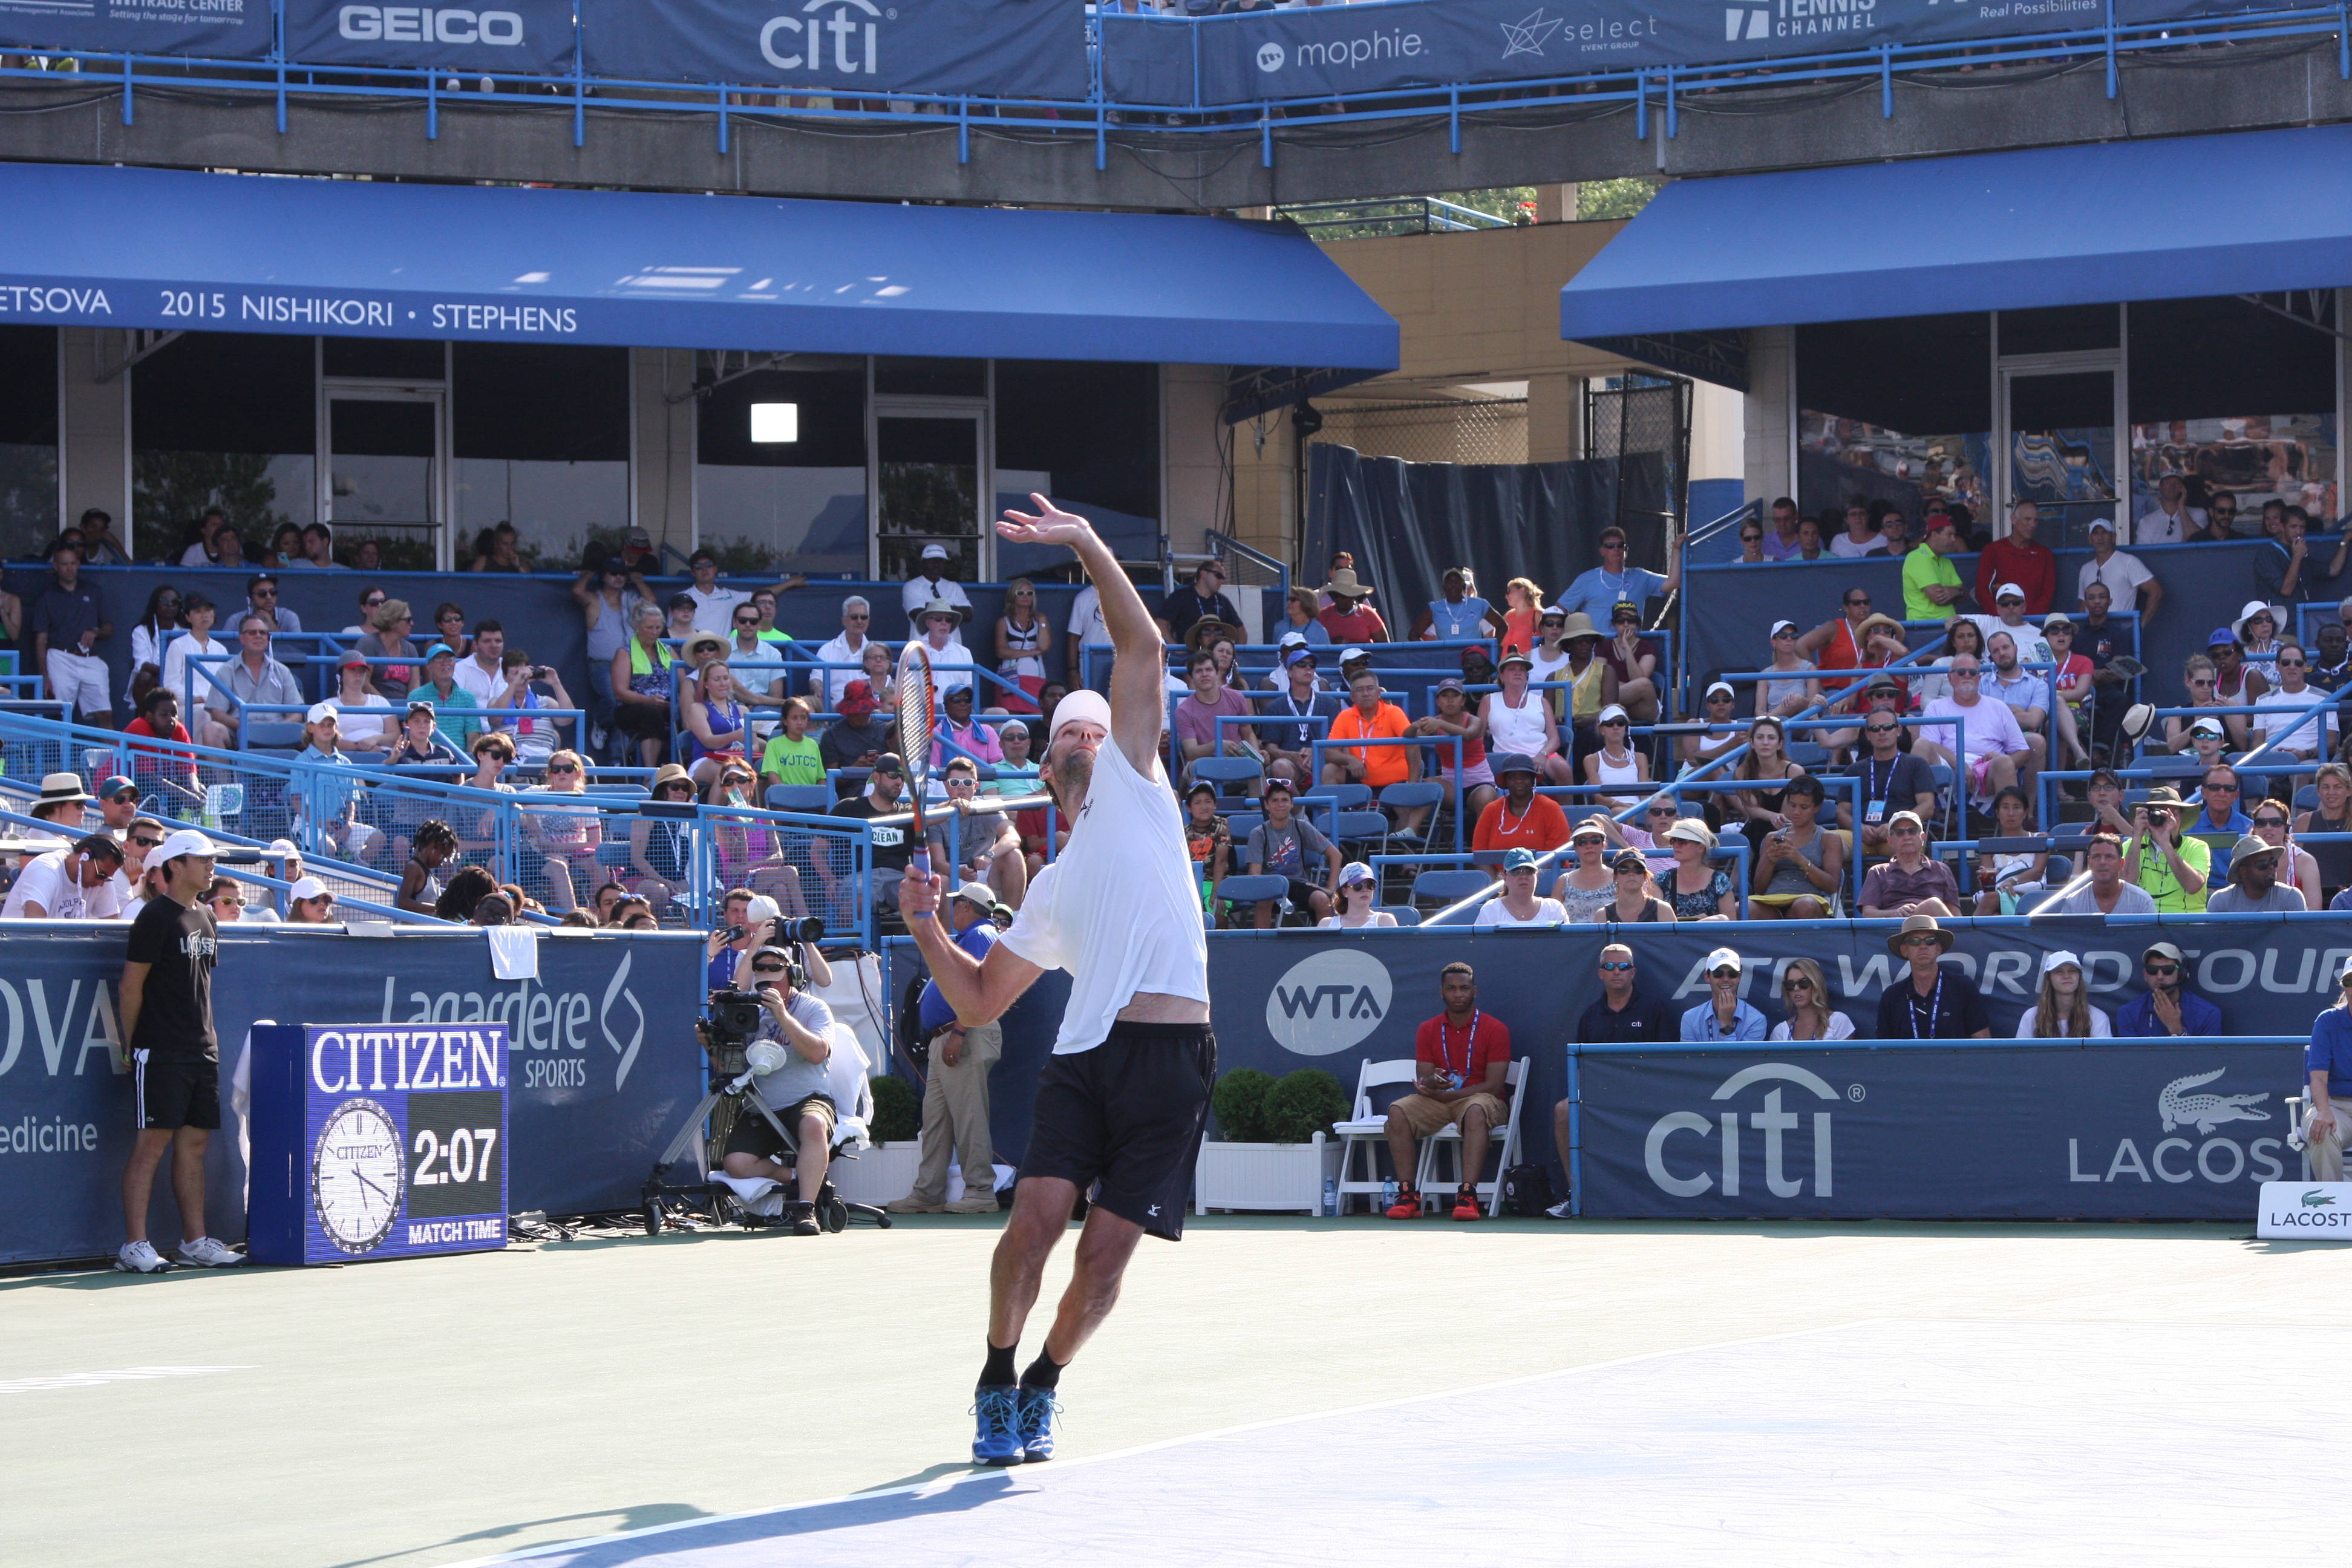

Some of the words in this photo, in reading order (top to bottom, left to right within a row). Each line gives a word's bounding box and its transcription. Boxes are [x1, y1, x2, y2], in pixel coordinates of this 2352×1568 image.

[109, 9, 140, 21] Setting
[143, 11, 156, 21] the
[159, 13, 183, 23] stage
[183, 13, 198, 24] for
[200, 15, 244, 25] tomorrow
[190, 0, 244, 12] CENTER
[1777, 0, 1875, 18] TENNIS
[1980, 3, 2009, 18] Real
[2014, 0, 2097, 15] Possibilities
[339, 5, 523, 46] GEICO
[1564, 15, 1657, 41] select
[1777, 13, 1873, 36] CHANNEL
[760, 5, 876, 74] citi
[1298, 28, 1422, 68] mophie
[1581, 43, 1608, 52] EVENT
[1610, 41, 1639, 51] GROUP
[161, 290, 226, 318] 2015
[243, 295, 392, 326] NISHIKORI
[433, 304, 577, 332] STEPHENS
[788, 755, 817, 768] JTCC
[872, 831, 898, 843] CLEAN
[2179, 948, 2352, 993] OUR
[1276, 985, 1382, 1019] WTA
[312, 1030, 501, 1093] CITIZEN
[525, 1058, 586, 1088] SPORTS
[337, 1145, 382, 1160] CITIZEN
[1645, 1087, 1832, 1198] citi
[413, 1128, 497, 1185] 2:07
[408, 1222, 462, 1244] MATCH
[465, 1219, 501, 1239] TIME
[2271, 1212, 2351, 1226] LACOST
